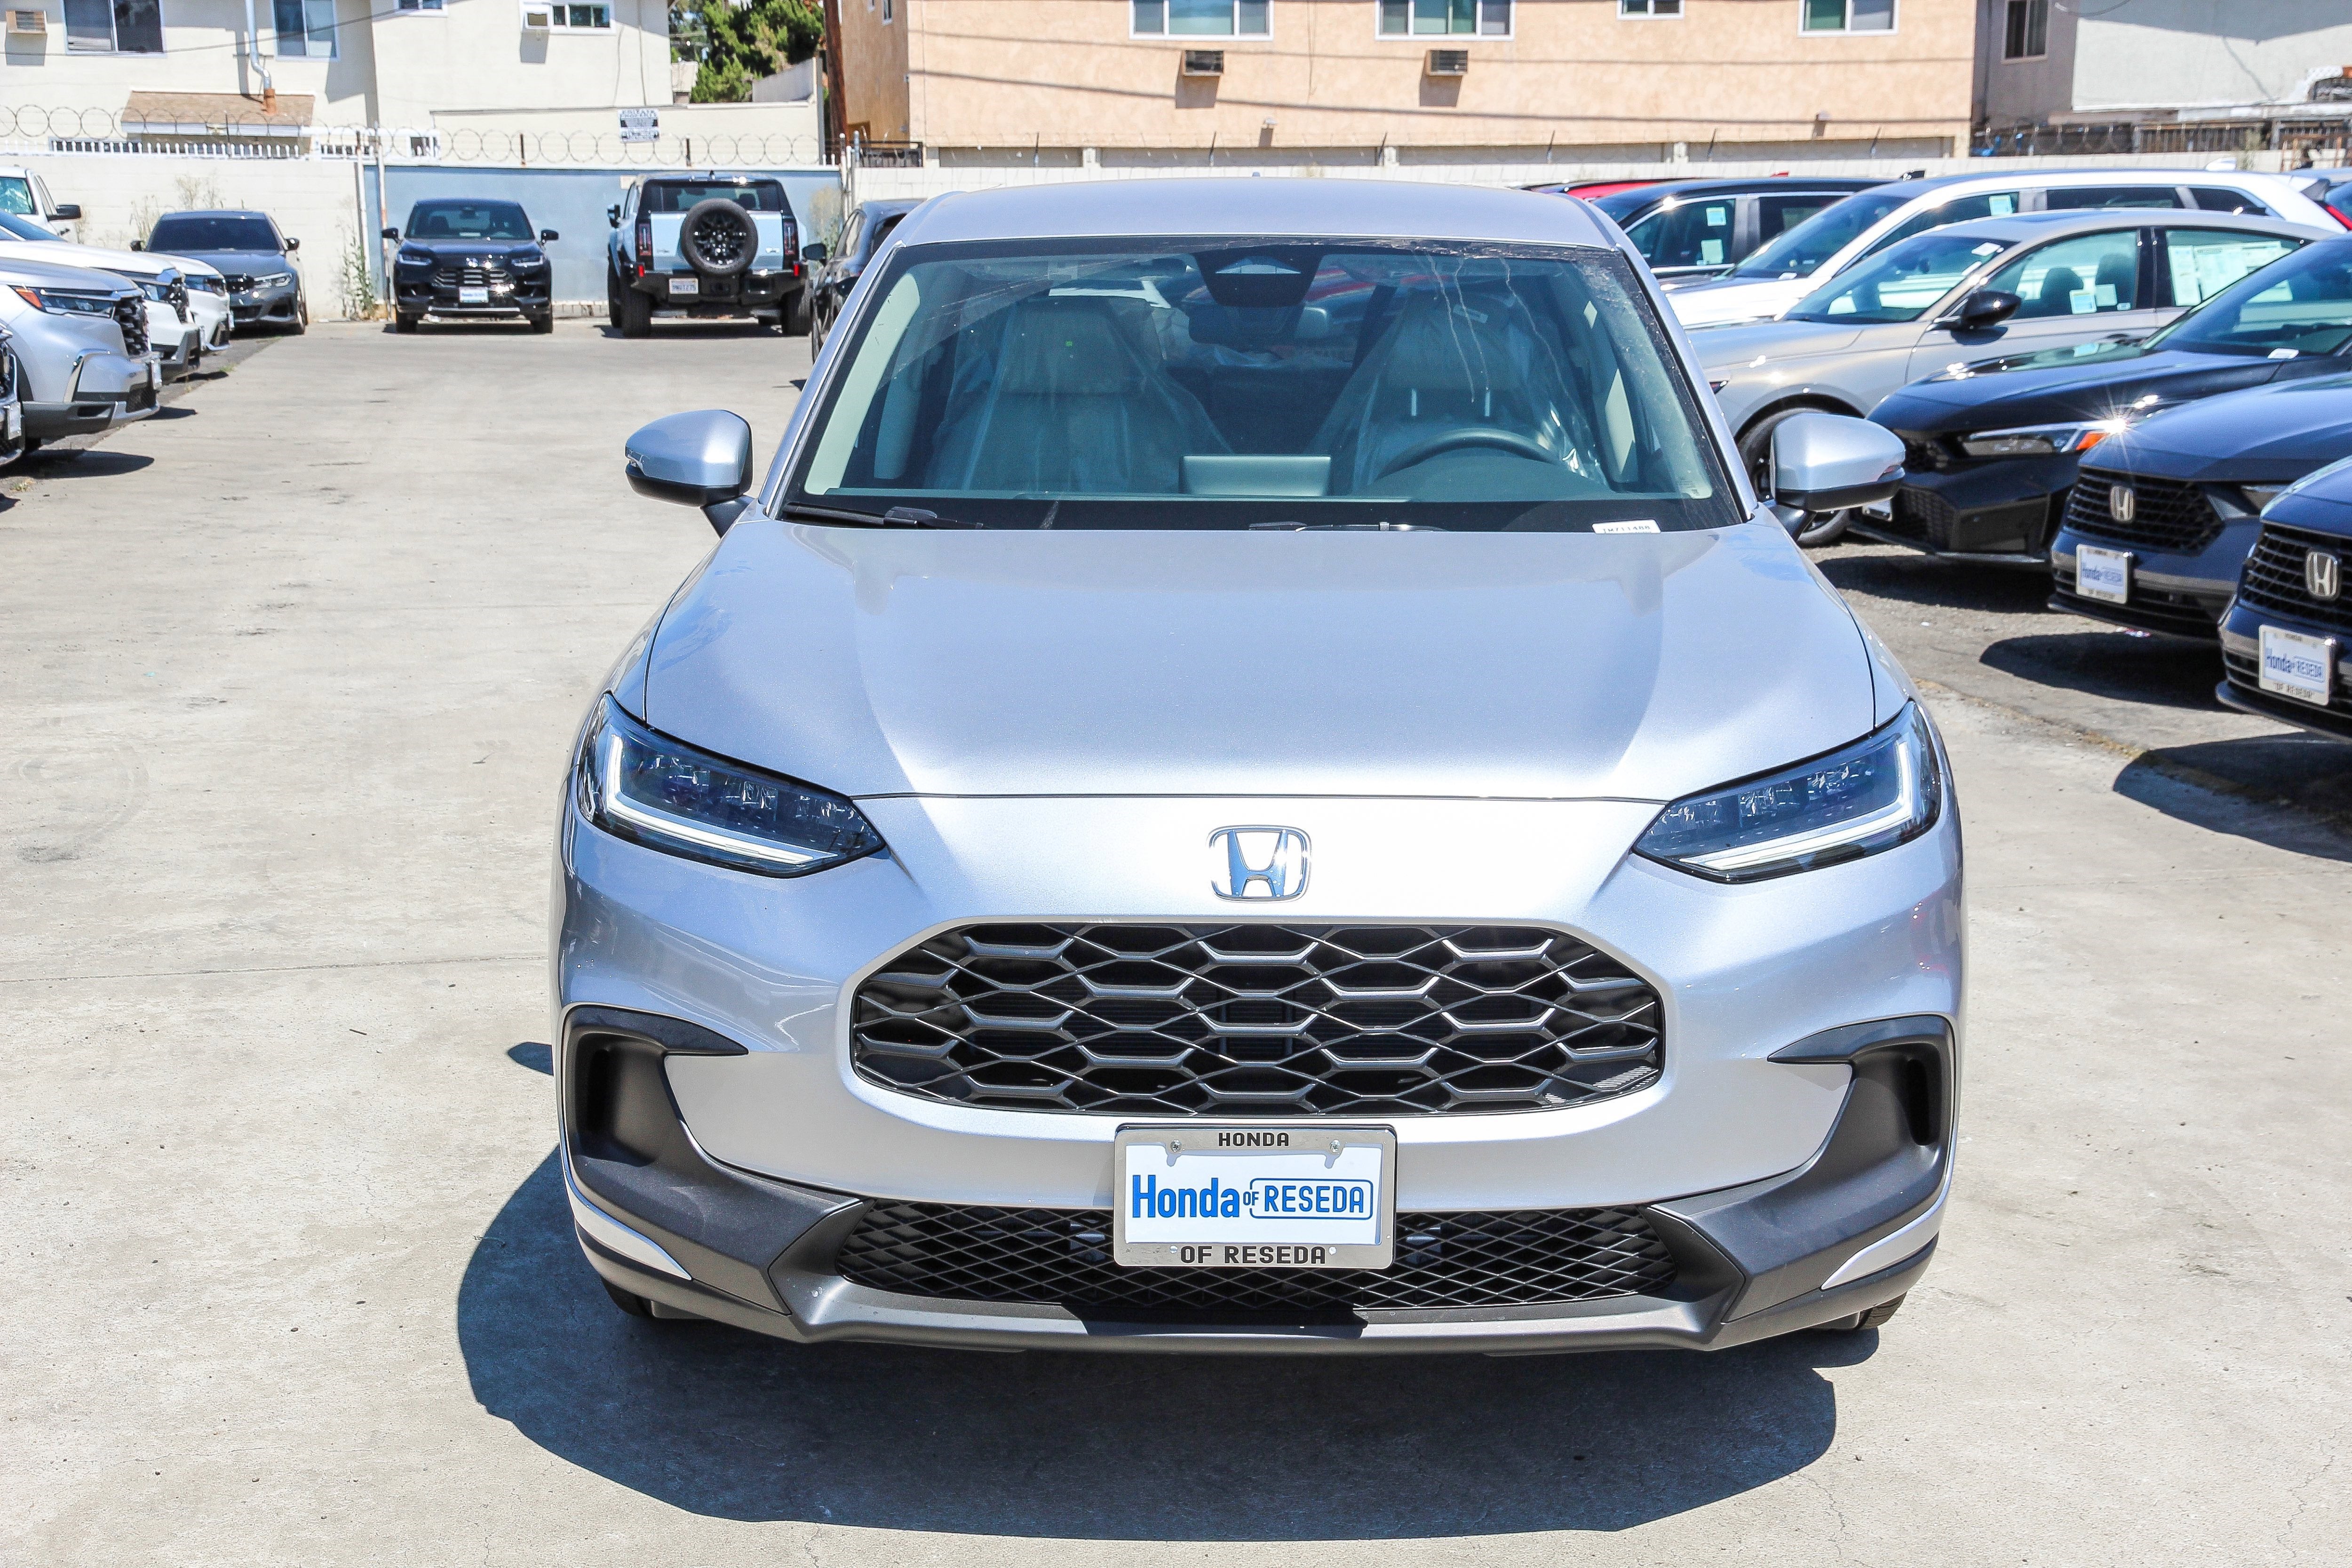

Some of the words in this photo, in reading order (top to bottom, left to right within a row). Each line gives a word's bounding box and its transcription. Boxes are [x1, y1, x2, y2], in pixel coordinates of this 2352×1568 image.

[1218, 1132, 1289, 1146] HONDA
[1132, 1175, 1240, 1218] Honda
[1243, 1191, 1259, 1206] OF
[1264, 1185, 1364, 1213] RESEDA
[1180, 1246, 1212, 1264] OF
[1224, 1245, 1326, 1264] RESEDA
